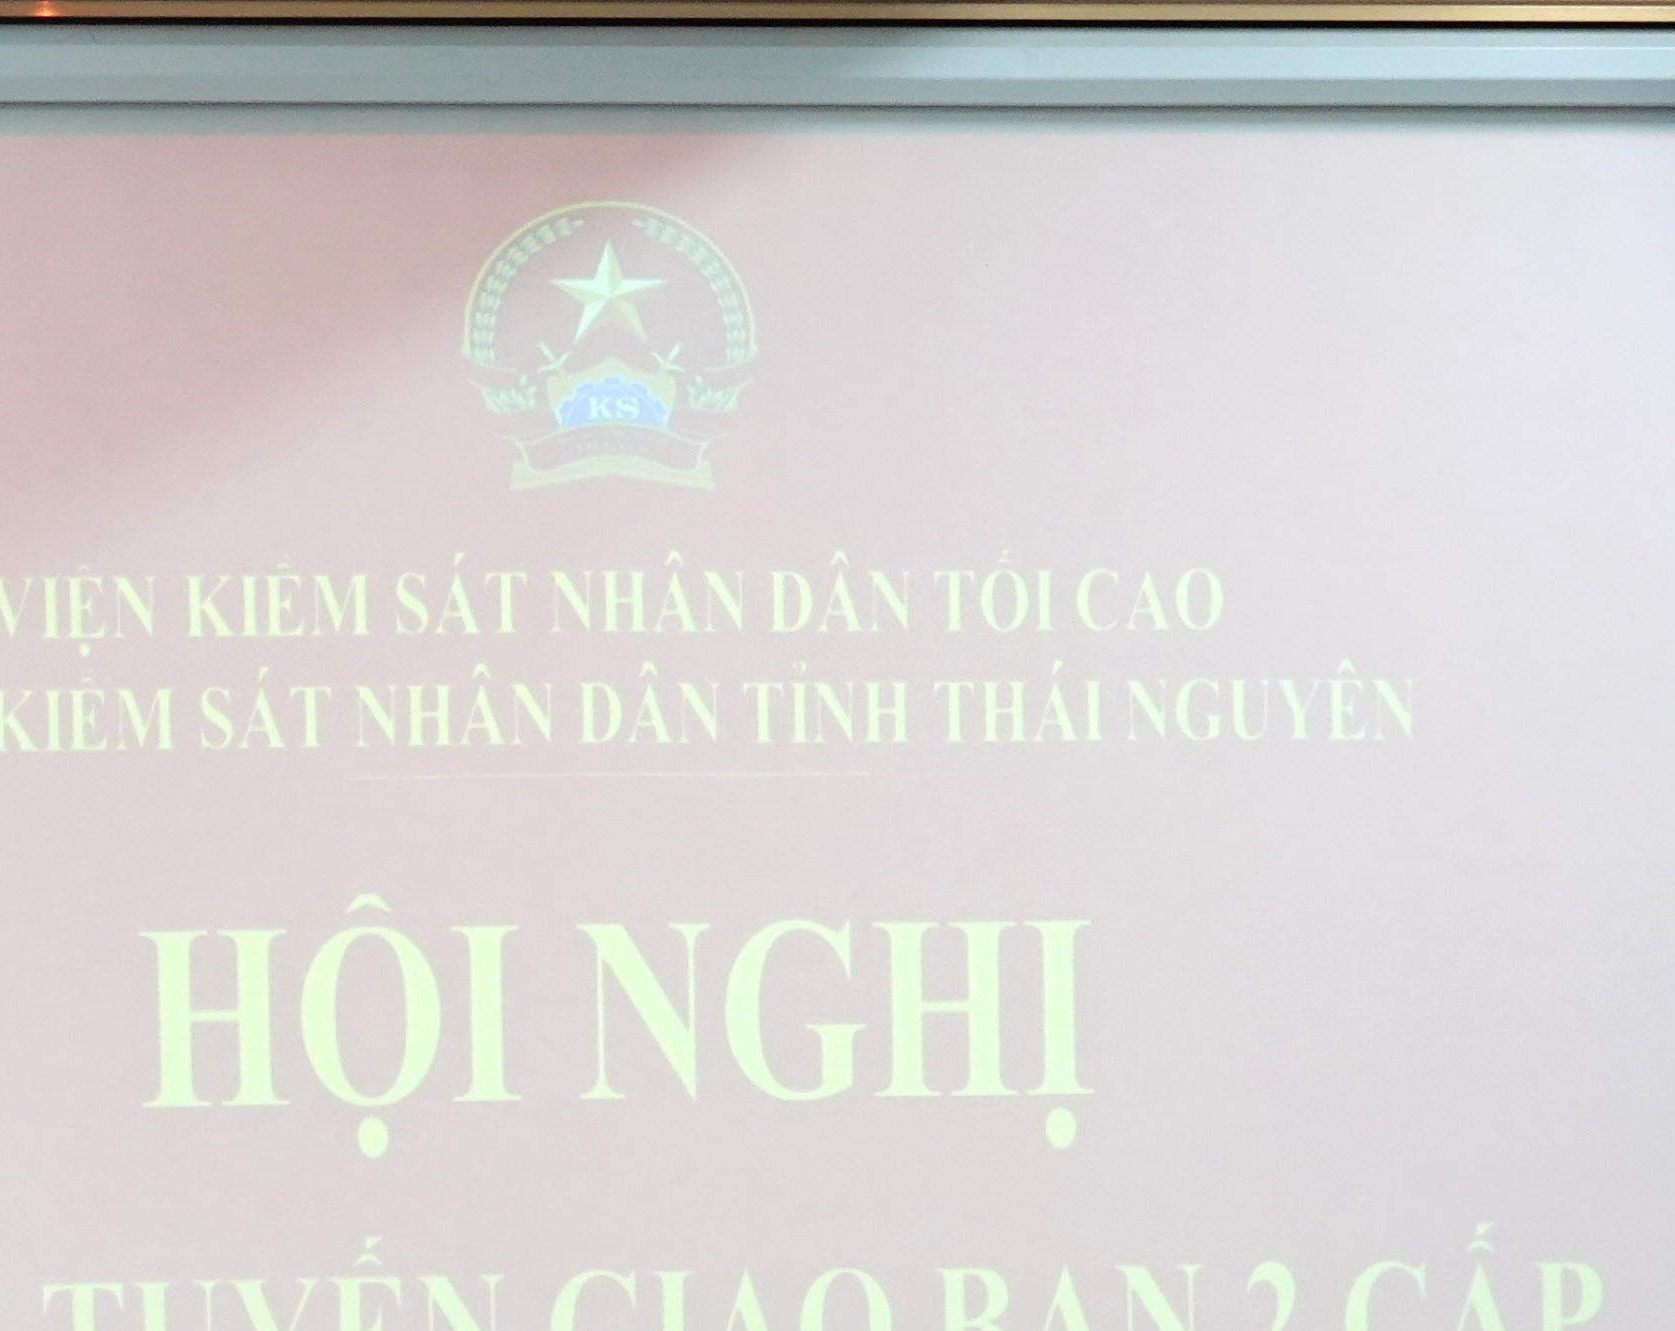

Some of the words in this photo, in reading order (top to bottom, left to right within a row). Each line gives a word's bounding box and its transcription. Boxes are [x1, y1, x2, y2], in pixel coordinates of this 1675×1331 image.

[587, 397, 641, 420] KS
[185, 555, 370, 638] KIỂM
[395, 552, 528, 636] SÁT
[551, 549, 745, 634] NHÂN
[770, 549, 910, 633] DÂN
[933, 549, 1052, 633] TỐI
[1075, 567, 1225, 632] CAO
[199, 667, 332, 750] SÁT
[356, 663, 553, 748] NHÂN
[577, 661, 720, 745] DÂN
[743, 660, 910, 744] TỈNH
[933, 660, 1103, 743] THÁI
[1127, 658, 1417, 741] NGUYÊN
[141, 892, 521, 1158] HỘI
[577, 917, 1095, 1150] NGHỊ
